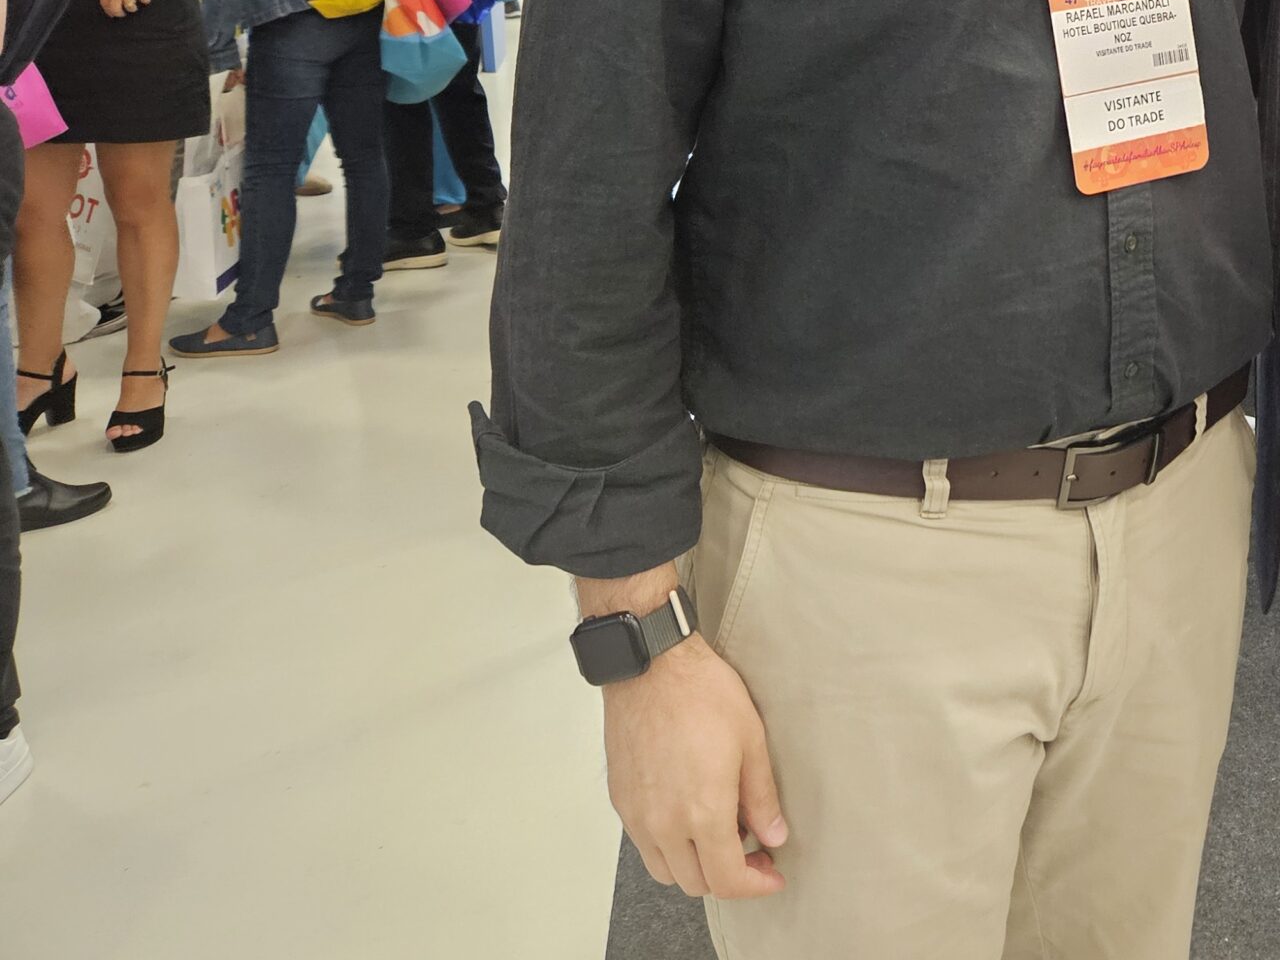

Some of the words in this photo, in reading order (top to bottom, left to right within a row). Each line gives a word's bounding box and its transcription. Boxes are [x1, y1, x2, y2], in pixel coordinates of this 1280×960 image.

[1063, 25, 1093, 39] HOTEL
[1093, 16, 1138, 34] BOUTIQUE
[1139, 10, 1178, 26] QUEBRA-
[1066, 8, 1105, 24] RAFAEL
[1114, 31, 1133, 44] NOZ
[1096, 45, 1124, 57] VISITANTE
[1125, 43, 1134, 52] DO
[1134, 41, 1152, 51] TRADE
[1104, 90, 1163, 113] VISITANTE
[1108, 117, 1126, 132] DO
[1127, 109, 1165, 128] TRADE
